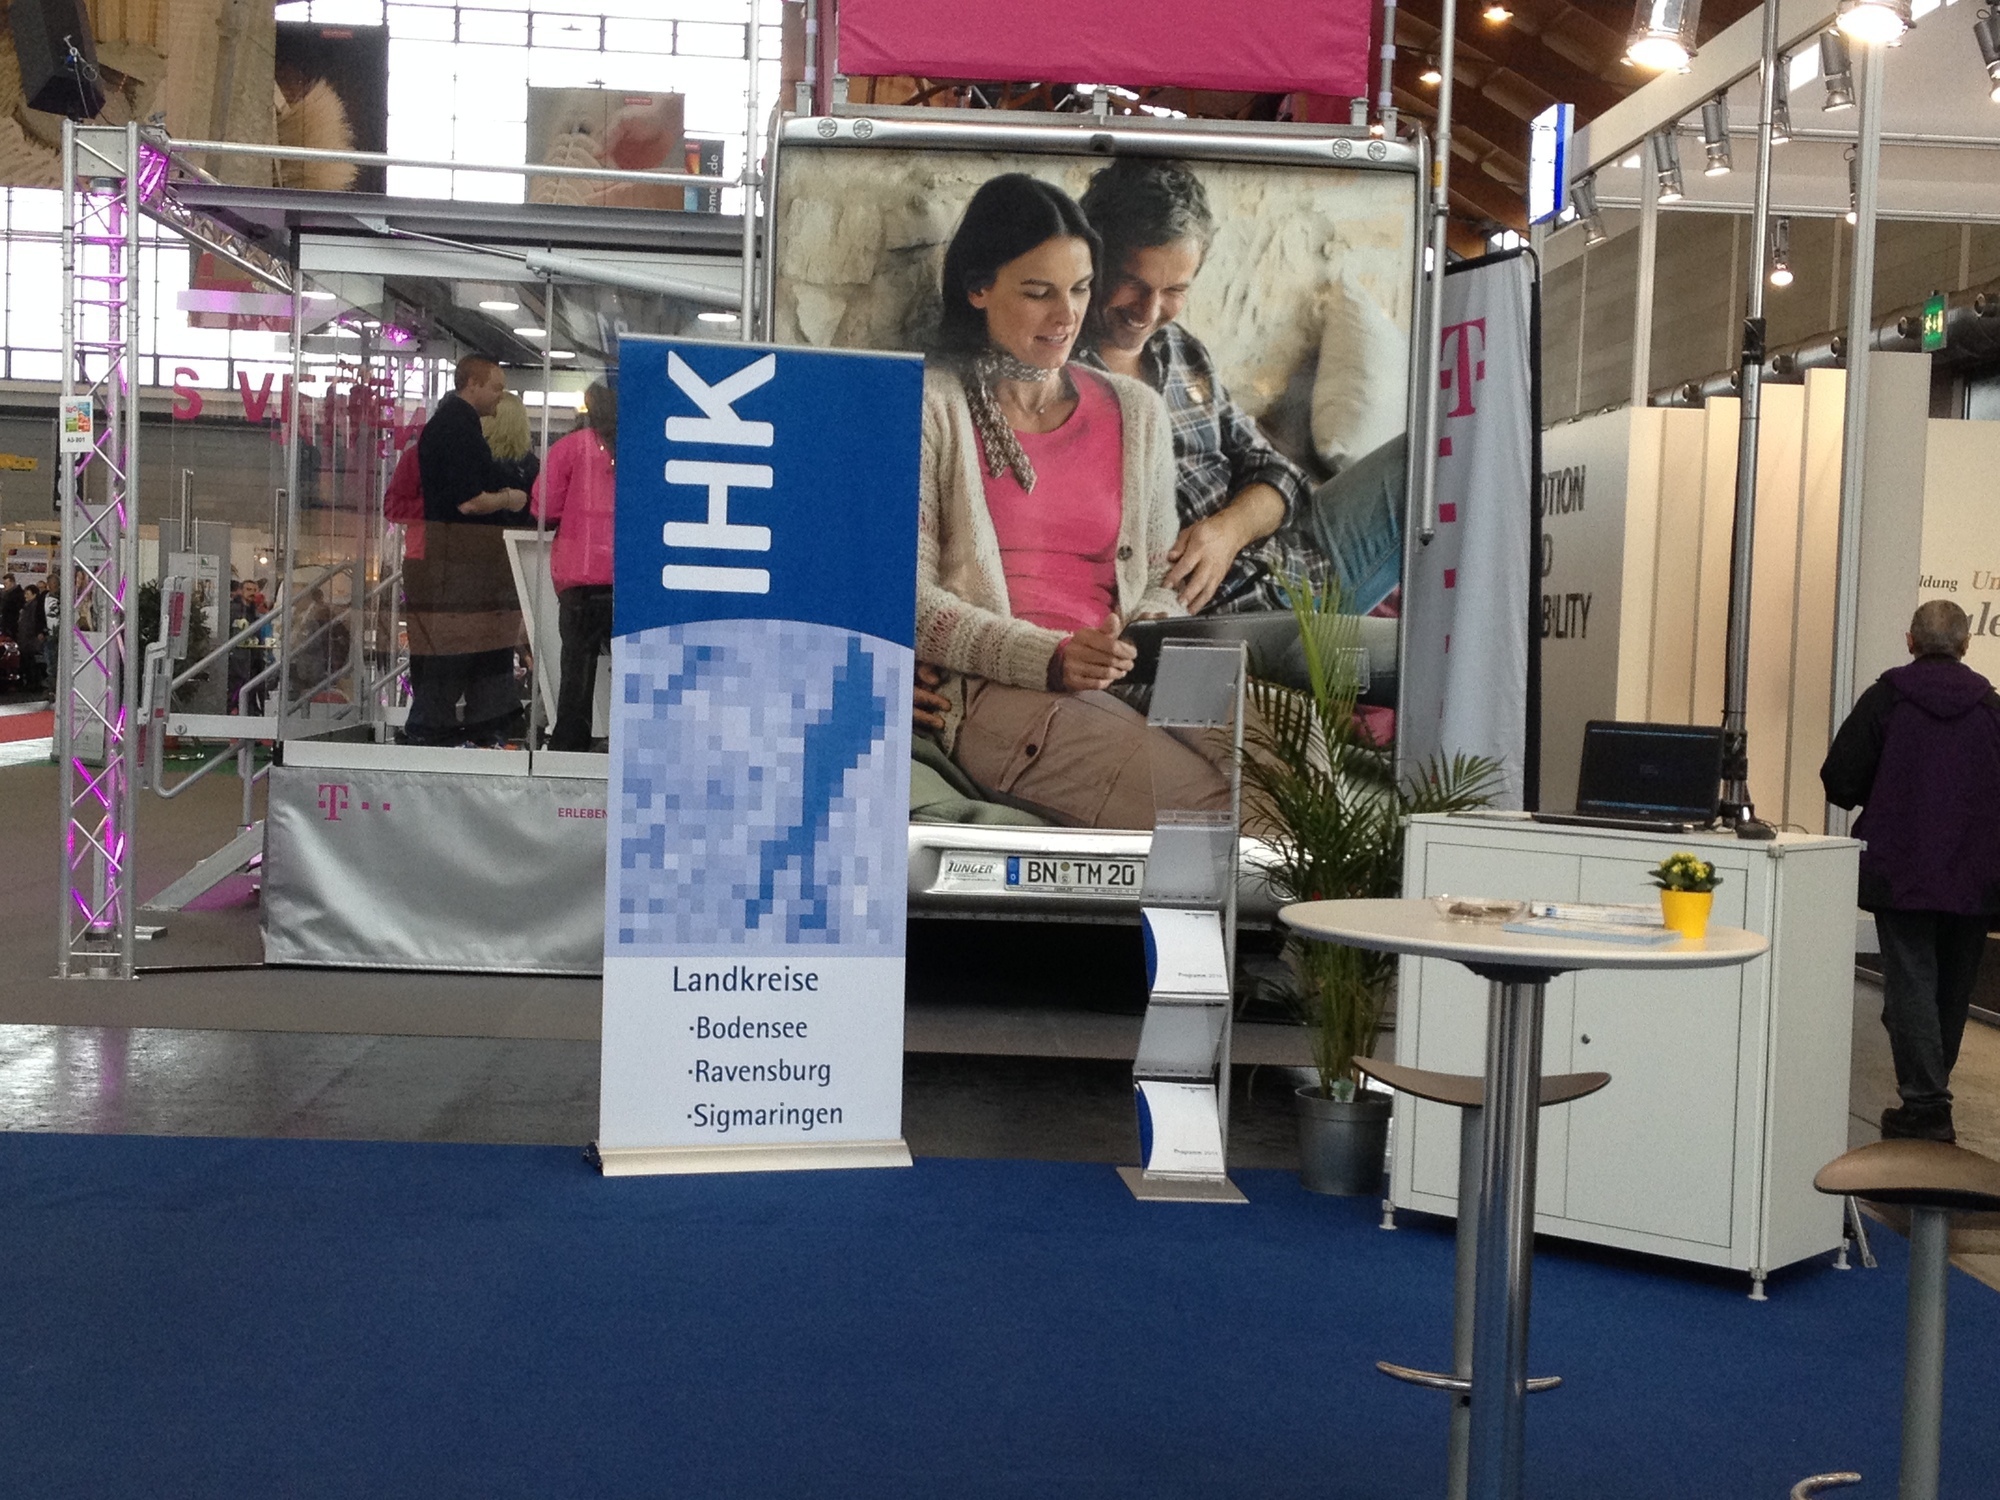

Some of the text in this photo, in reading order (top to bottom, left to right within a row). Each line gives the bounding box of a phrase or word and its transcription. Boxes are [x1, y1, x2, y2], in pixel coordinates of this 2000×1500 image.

[662, 350, 776, 594] IHK
[1966, 601, 2000, 637] le
[558, 807, 607, 819] ERLEBEN
[1028, 861, 1057, 884] BN
[1073, 862, 1102, 885] TM
[1107, 864, 1135, 886] 20
[673, 965, 819, 992] Landkreise
